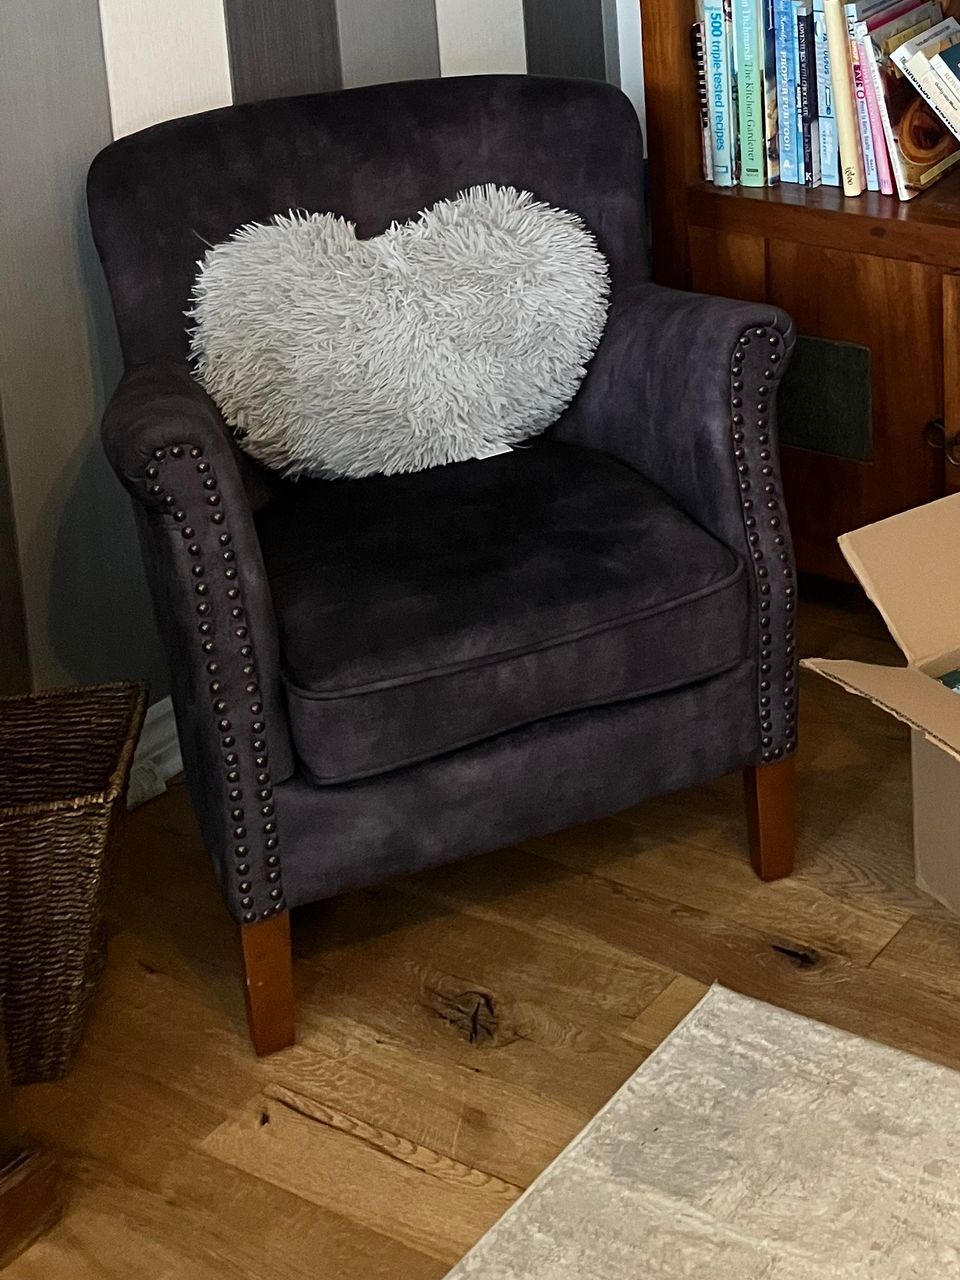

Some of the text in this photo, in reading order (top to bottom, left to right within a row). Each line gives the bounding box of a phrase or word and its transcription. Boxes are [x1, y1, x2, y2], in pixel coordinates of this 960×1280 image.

[742, 9, 753, 61] Titchmarsh
[711, 12, 726, 151] 500 triple-tested recipes
[780, 51, 791, 151] PROPER PUB FOOD
[801, 80, 809, 117] CHOCOLATE
[853, 64, 864, 88] SAVE
[744, 62, 757, 161] The Kitchen Gardener
[844, 166, 856, 186] igloo
